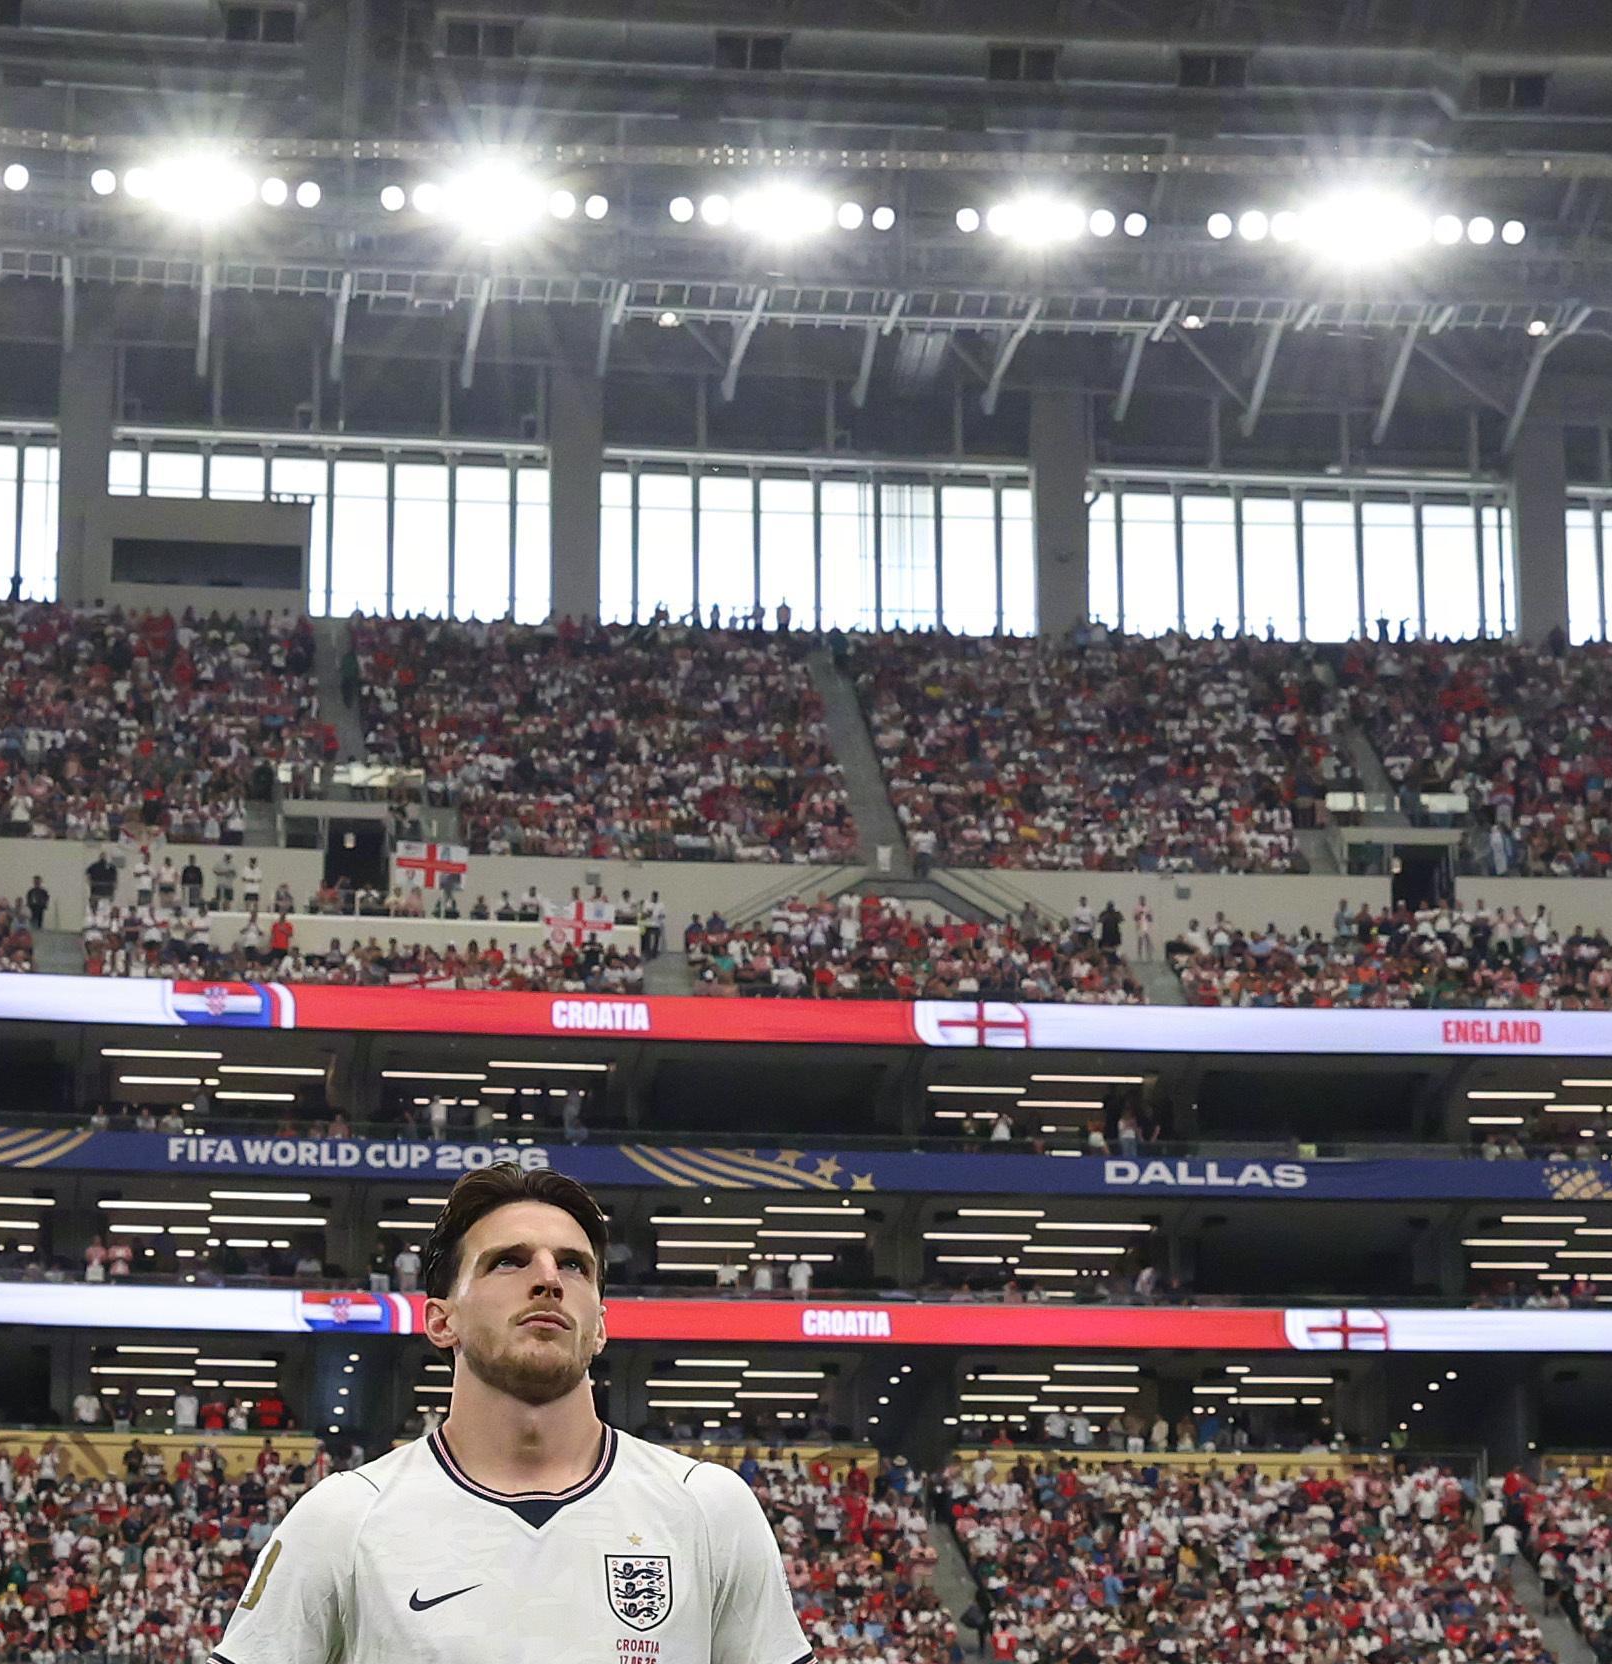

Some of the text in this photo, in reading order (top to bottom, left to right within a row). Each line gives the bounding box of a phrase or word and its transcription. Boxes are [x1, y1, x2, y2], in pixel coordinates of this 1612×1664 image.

[552, 1000, 650, 1031] CROATIA
[1442, 1020, 1542, 1044] ENGLAND
[168, 1137, 549, 1170] FIFA WORLD CUP 2026
[1104, 1160, 1307, 1188] DALLAS
[802, 1308, 891, 1338] CROATIA
[616, 1639, 660, 1654] CROATIA
